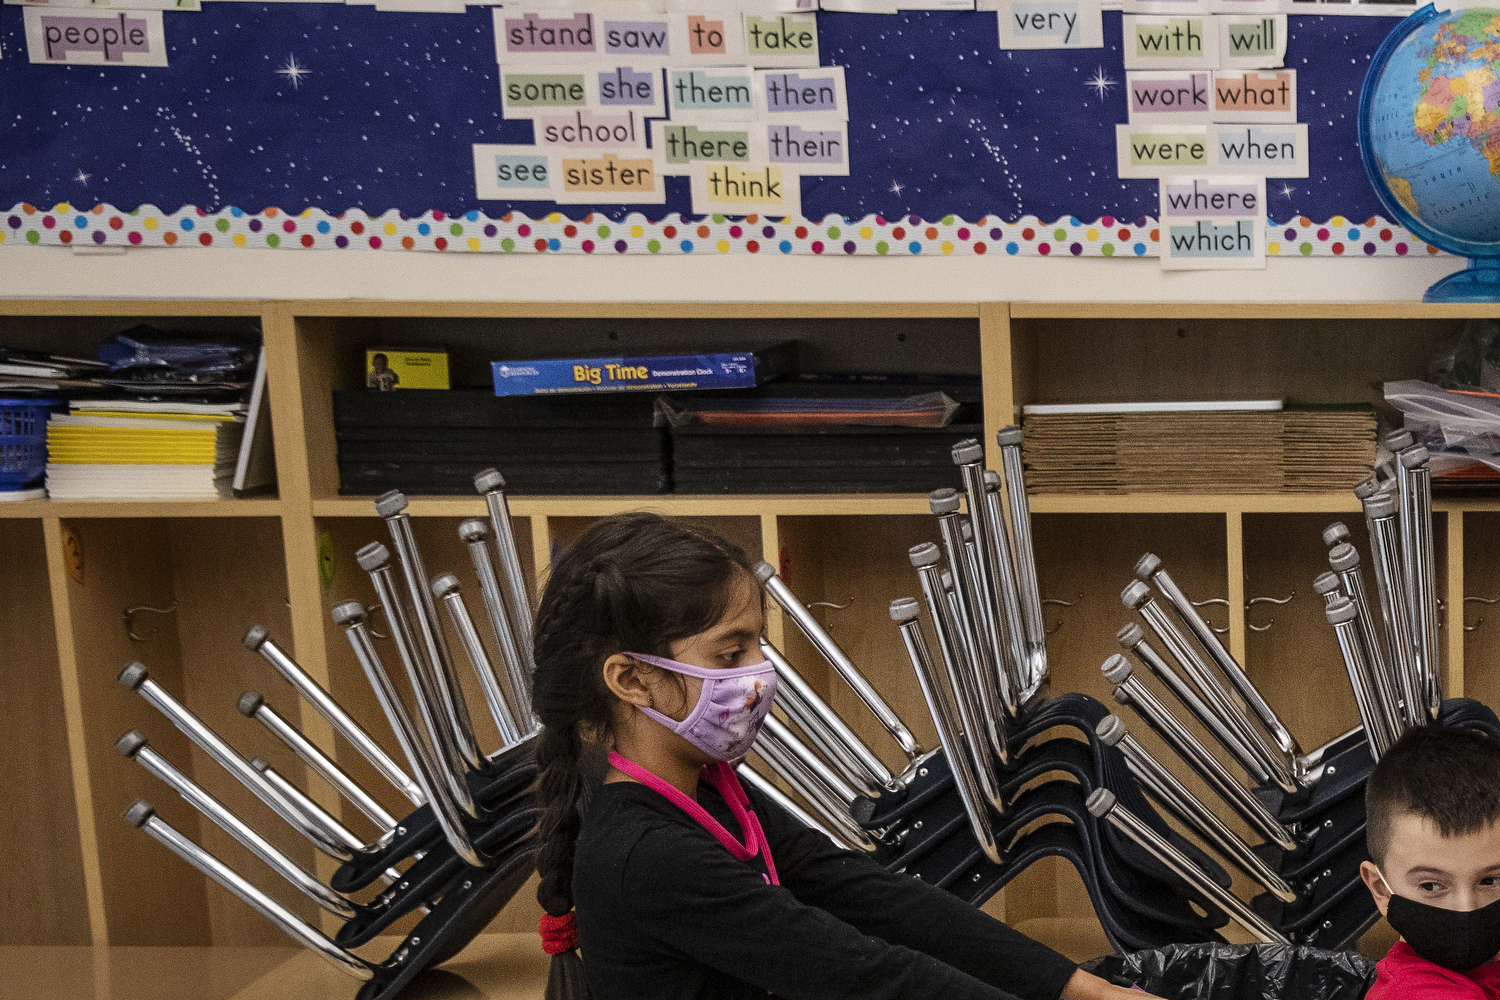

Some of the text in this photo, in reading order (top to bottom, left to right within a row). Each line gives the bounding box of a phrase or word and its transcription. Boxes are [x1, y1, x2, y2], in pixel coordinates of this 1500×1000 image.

[45, 13, 145, 60] people
[510, 13, 594, 47] stand
[607, 27, 667, 50] saw
[692, 23, 724, 50] to
[750, 17, 814, 50] take
[1015, 12, 1077, 45] very
[1138, 21, 1201, 52] with
[1230, 19, 1275, 51] will
[508, 78, 585, 102] some
[601, 67, 652, 100] she
[674, 72, 751, 105] them
[768, 75, 834, 107] then
[1134, 74, 1207, 107] work
[1217, 74, 1290, 107] what
[545, 111, 636, 144] school
[666, 127, 749, 159] there
[770, 125, 840, 159] their
[1133, 140, 1205, 161] were
[1221, 129, 1295, 161] when
[498, 159, 548, 183] see
[566, 161, 651, 187] sister
[709, 166, 782, 199] think
[1168, 180, 1257, 211] where
[1172, 221, 1252, 252] which
[573, 364, 602, 385] Big
[604, 363, 649, 380] Time
[652, 369, 697, 377] Demonstration
[697, 367, 714, 376] Clock
